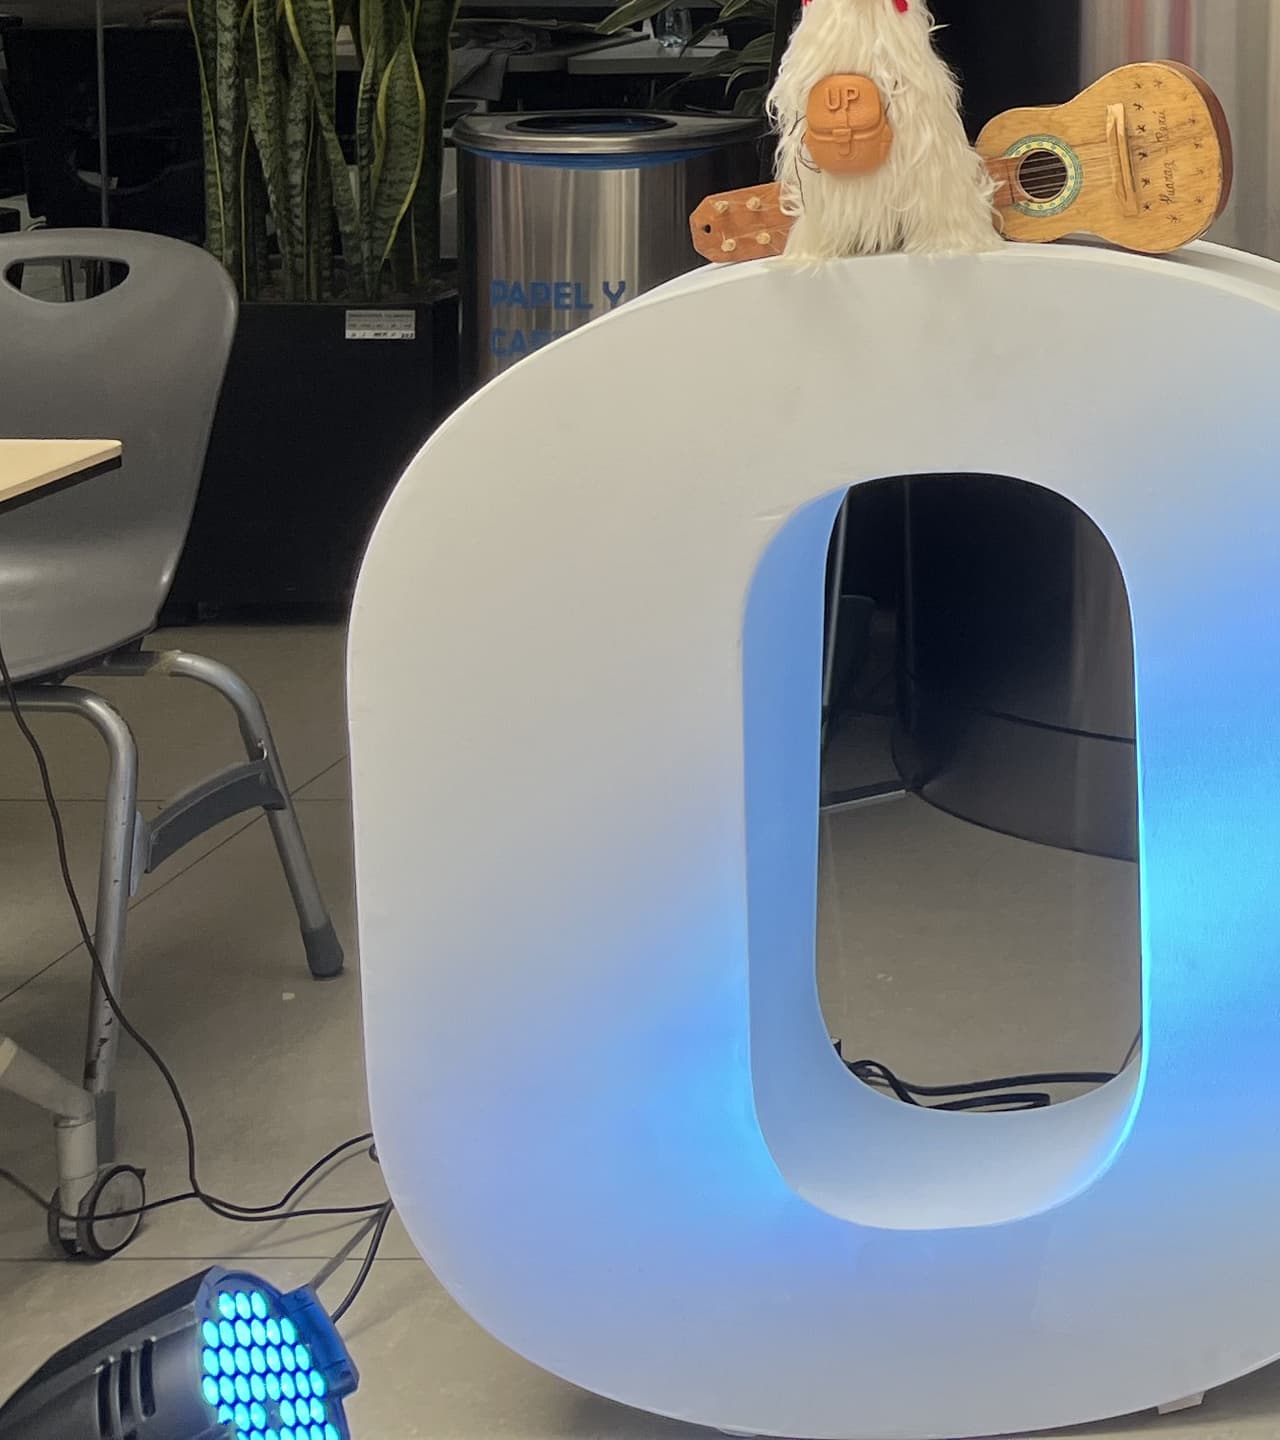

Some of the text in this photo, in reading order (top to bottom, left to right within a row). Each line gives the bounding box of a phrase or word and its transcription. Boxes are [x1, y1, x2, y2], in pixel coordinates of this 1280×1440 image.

[824, 87, 860, 110] UP
[490, 279, 626, 309] PAPEL Y
